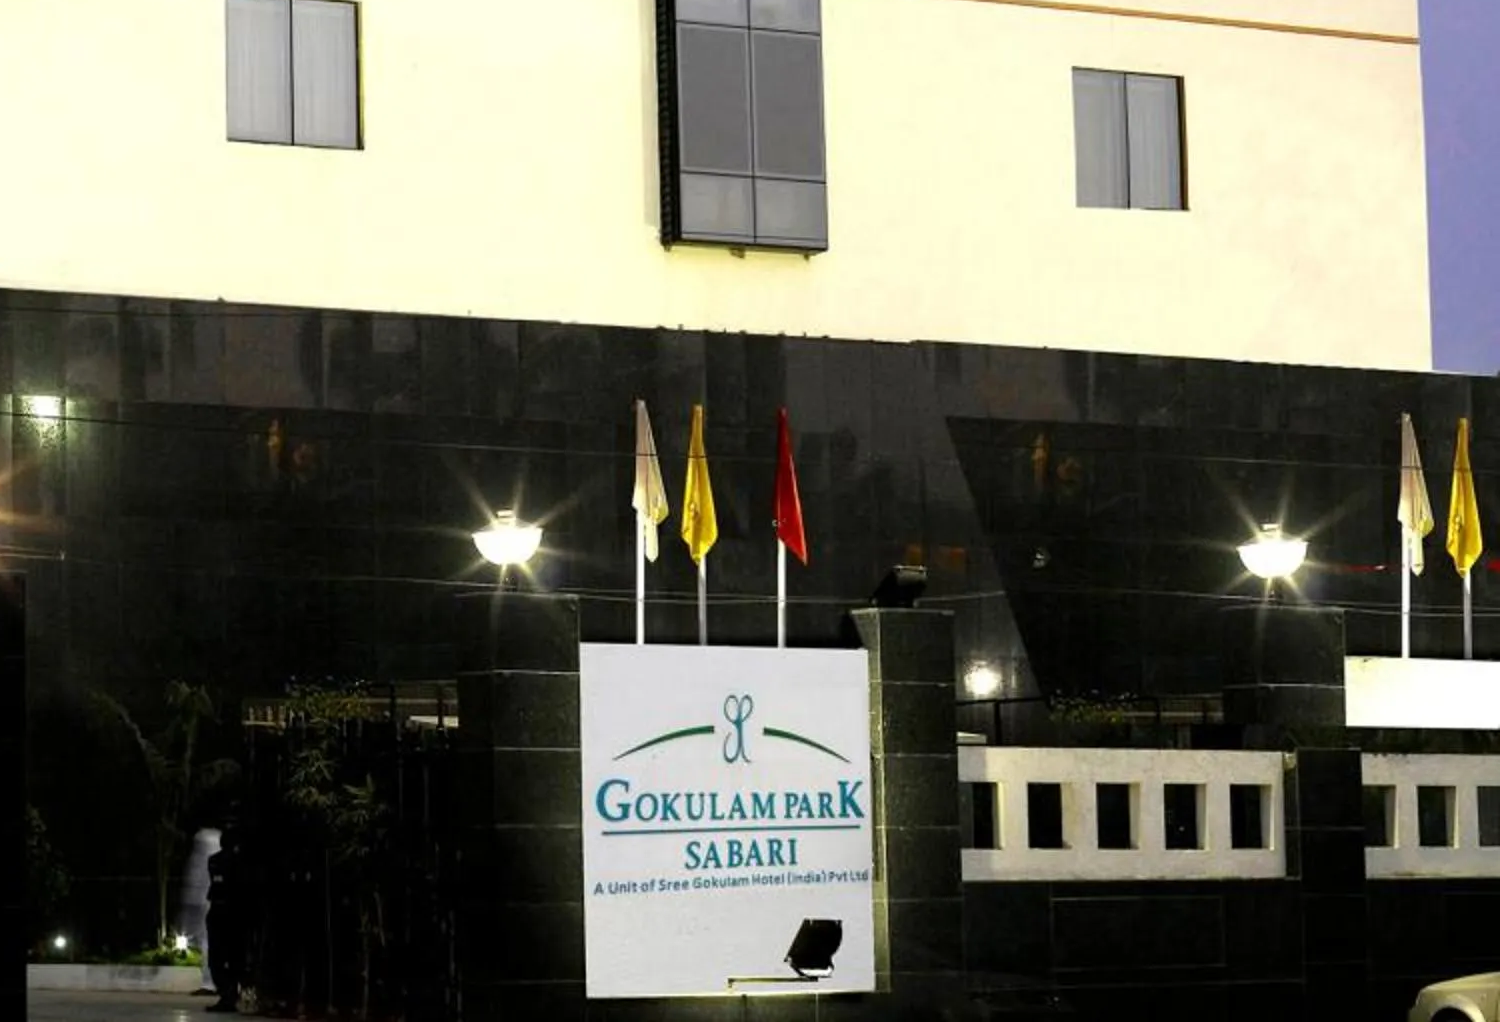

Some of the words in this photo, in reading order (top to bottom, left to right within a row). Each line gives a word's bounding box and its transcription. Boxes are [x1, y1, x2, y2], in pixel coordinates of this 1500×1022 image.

[684, 838, 798, 870] SABARI
[594, 882, 604, 895] A
[607, 881, 638, 895] Unit
[639, 879, 655, 892] of
[659, 878, 689, 892] Sree
[692, 875, 750, 889] Gokulam
[751, 873, 785, 886] Hotel
[828, 870, 848, 883] Pvt
[849, 869, 869, 882] Ltd
